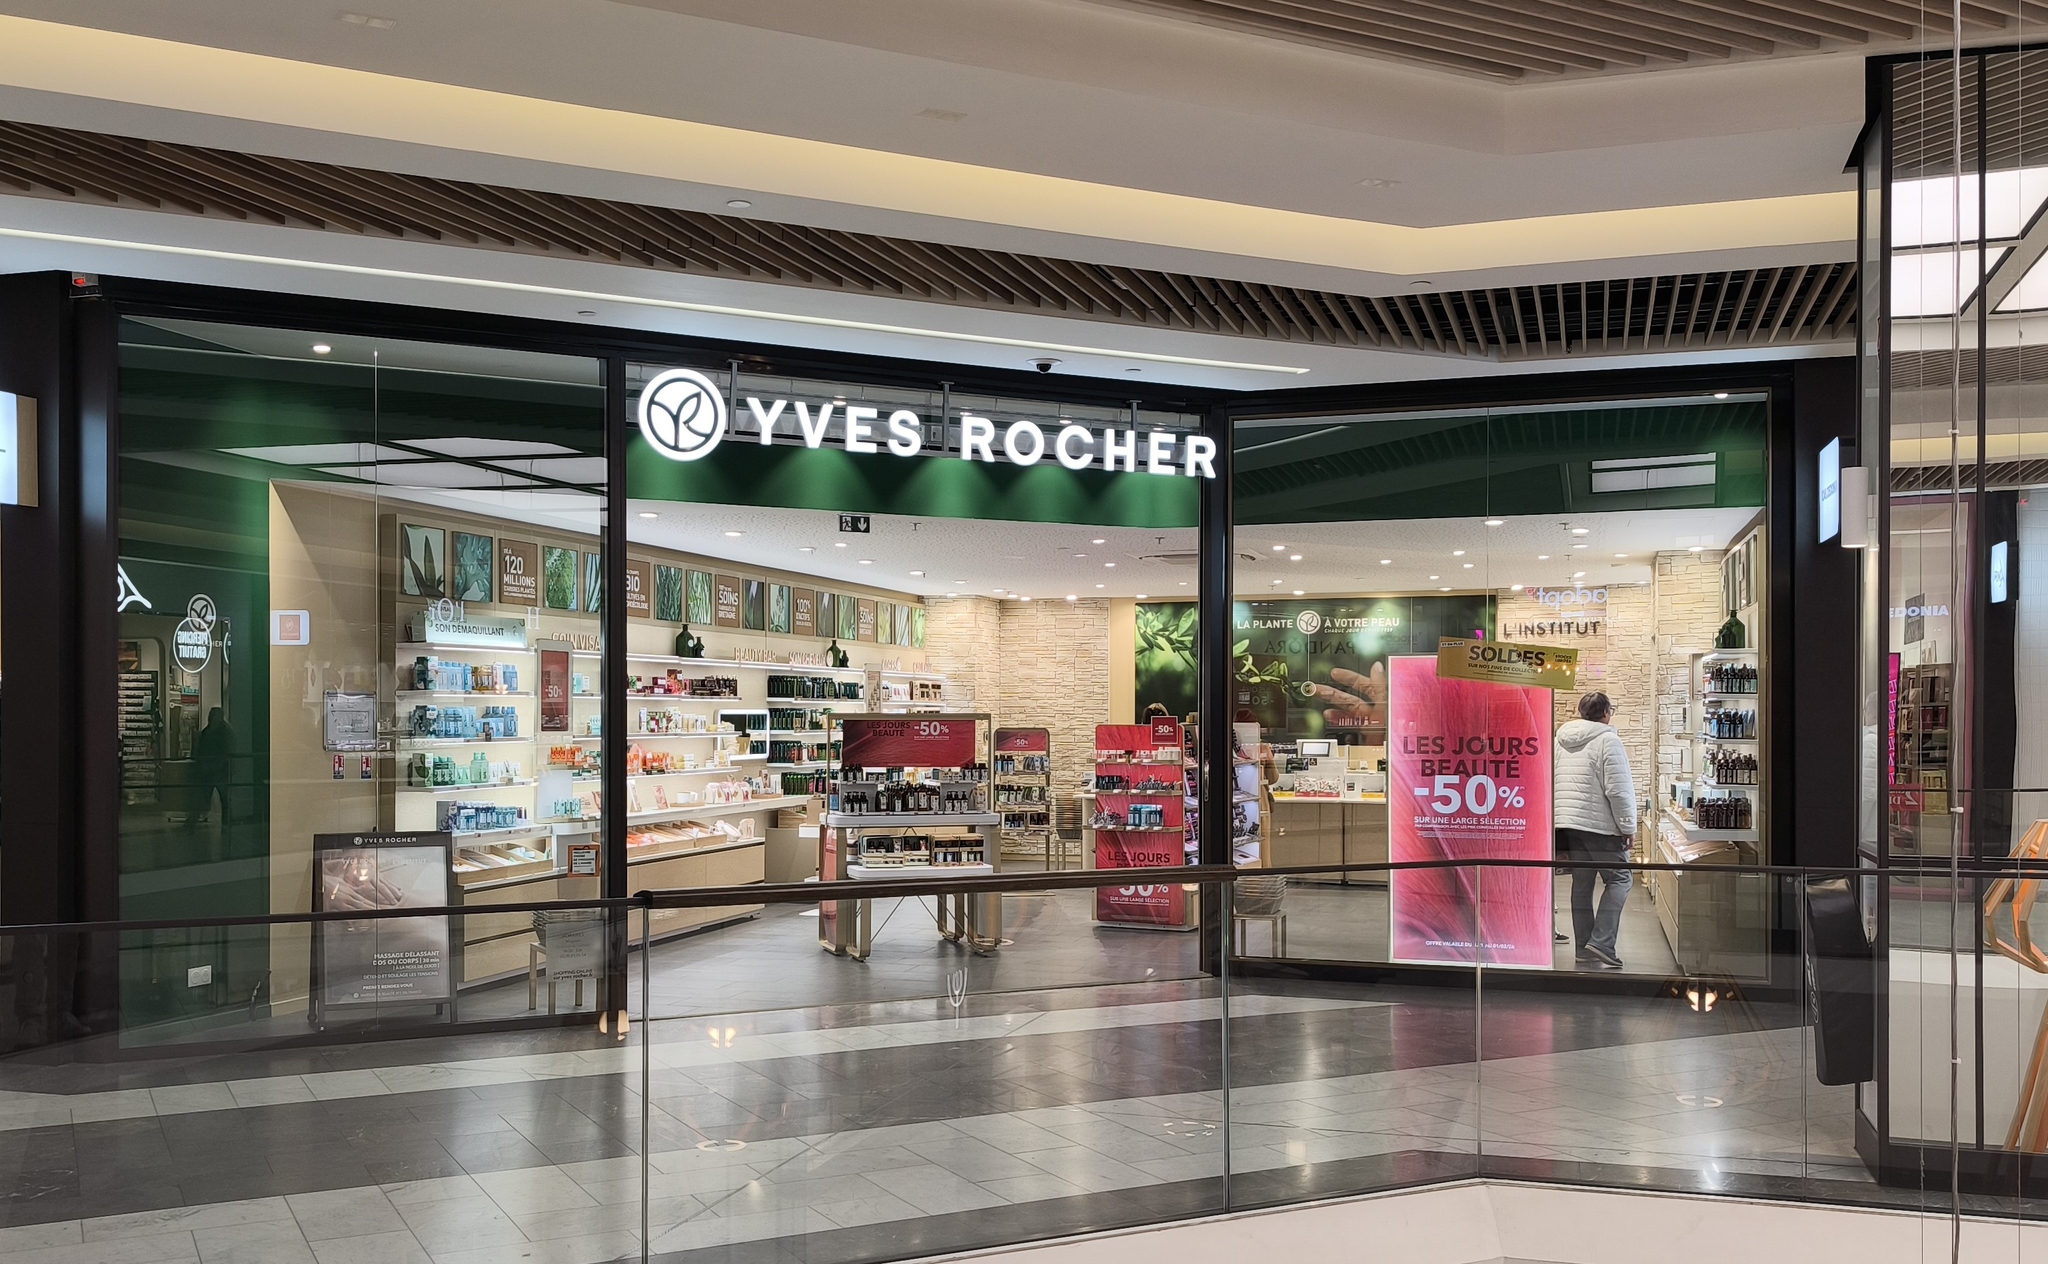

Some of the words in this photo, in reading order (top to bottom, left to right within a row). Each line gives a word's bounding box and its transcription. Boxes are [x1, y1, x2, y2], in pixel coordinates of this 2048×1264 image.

[746, 396, 922, 458] YVES
[960, 415, 1217, 479] ROCHER
[504, 555, 524, 574] 120
[503, 574, 536, 587] MILLIONS
[718, 590, 738, 606] SOINS
[796, 598, 811, 612] 100%
[434, 623, 451, 633] SON
[1237, 620, 1251, 630] LA
[1252, 619, 1294, 630] PLANTE
[1324, 616, 1332, 628] À
[1333, 617, 1368, 628] VOTRE
[1370, 617, 1400, 627] PEAU
[1503, 621, 1601, 637] L'INSTITUT
[734, 647, 762, 662] BEAUTY
[763, 650, 777, 663] BAR
[1469, 645, 1546, 667] SOLDES
[913, 721, 950, 736] -50%
[1155, 724, 1174, 734] -50%
[1403, 736, 1446, 755] LES
[1451, 736, 1539, 756] JOURS
[1421, 755, 1520, 778] BEAUTÉ
[1413, 774, 1525, 815] -50%
[1413, 816, 1431, 824] SUR
[1431, 816, 1449, 824] UNE
[1451, 817, 1478, 825] LARGE
[1479, 817, 1527, 826] SÉLECTION
[1108, 851, 1130, 862] LES
[1131, 852, 1171, 864] JOURS
[404, 950, 440, 958] DÉLASSANT
